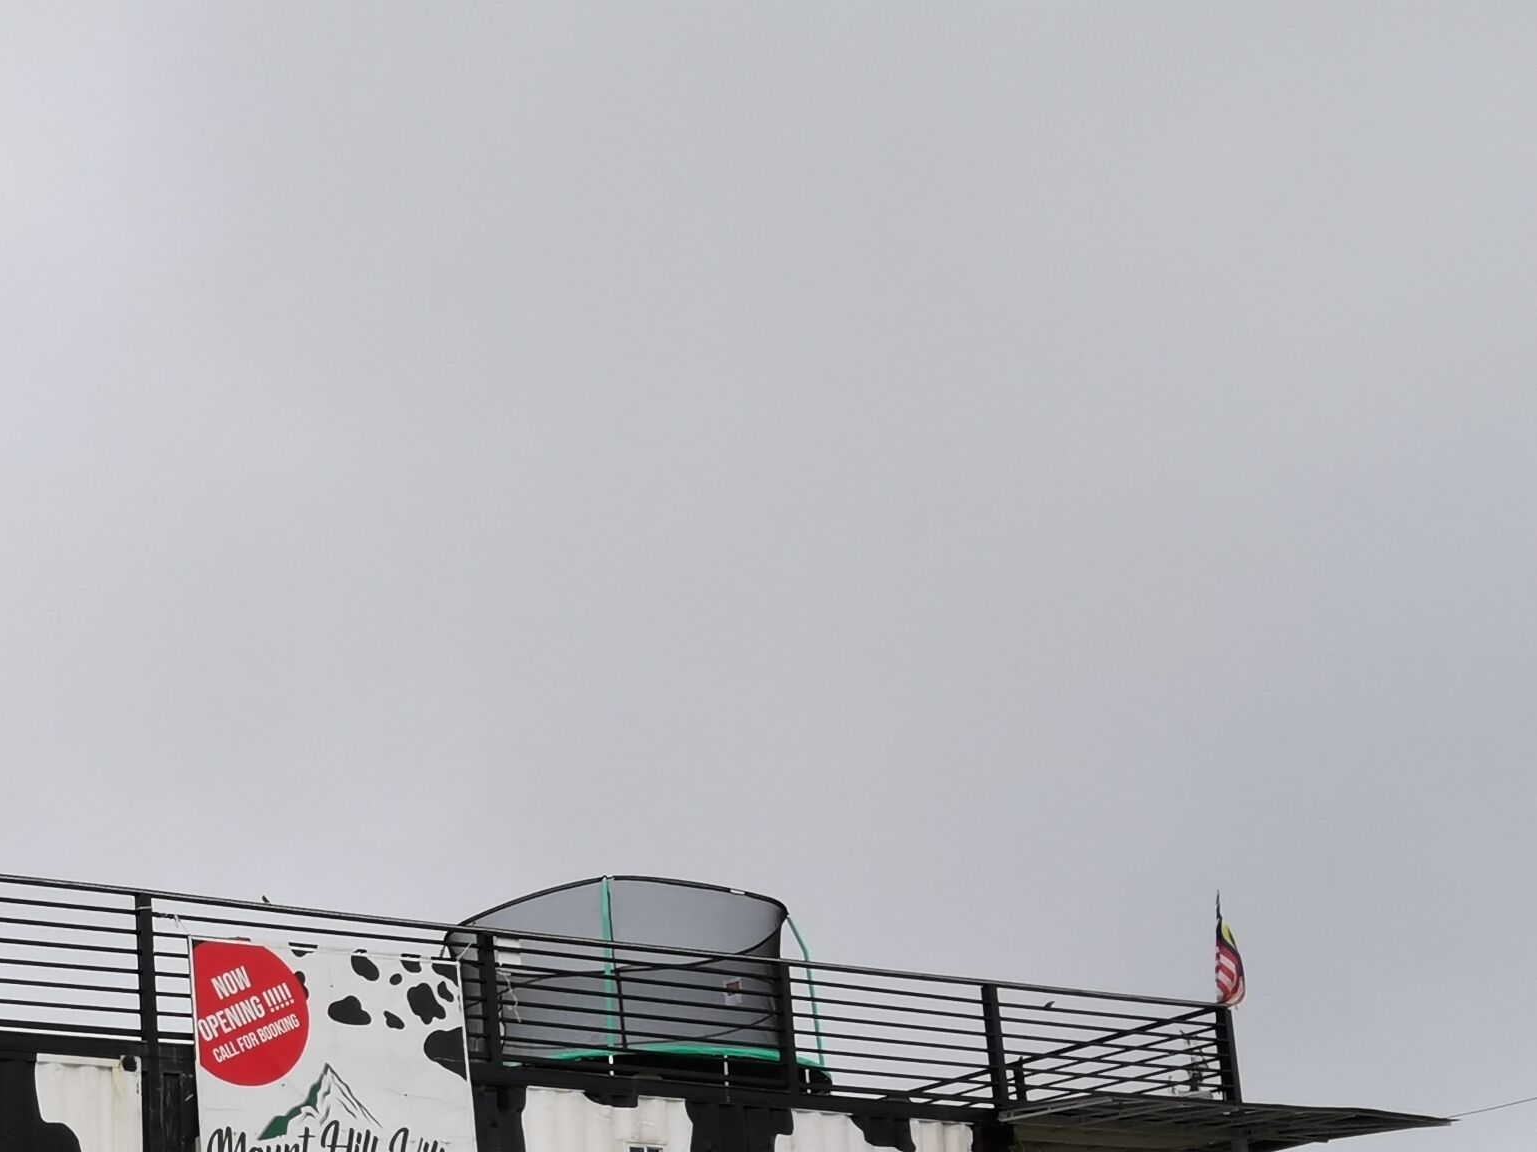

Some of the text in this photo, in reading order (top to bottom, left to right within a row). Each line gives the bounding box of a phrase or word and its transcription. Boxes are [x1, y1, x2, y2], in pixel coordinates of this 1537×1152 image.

[210, 965, 252, 1000] NOW
[197, 996, 265, 1042] OPENING
[212, 1013, 301, 1064] CALL FOR BOOKING
